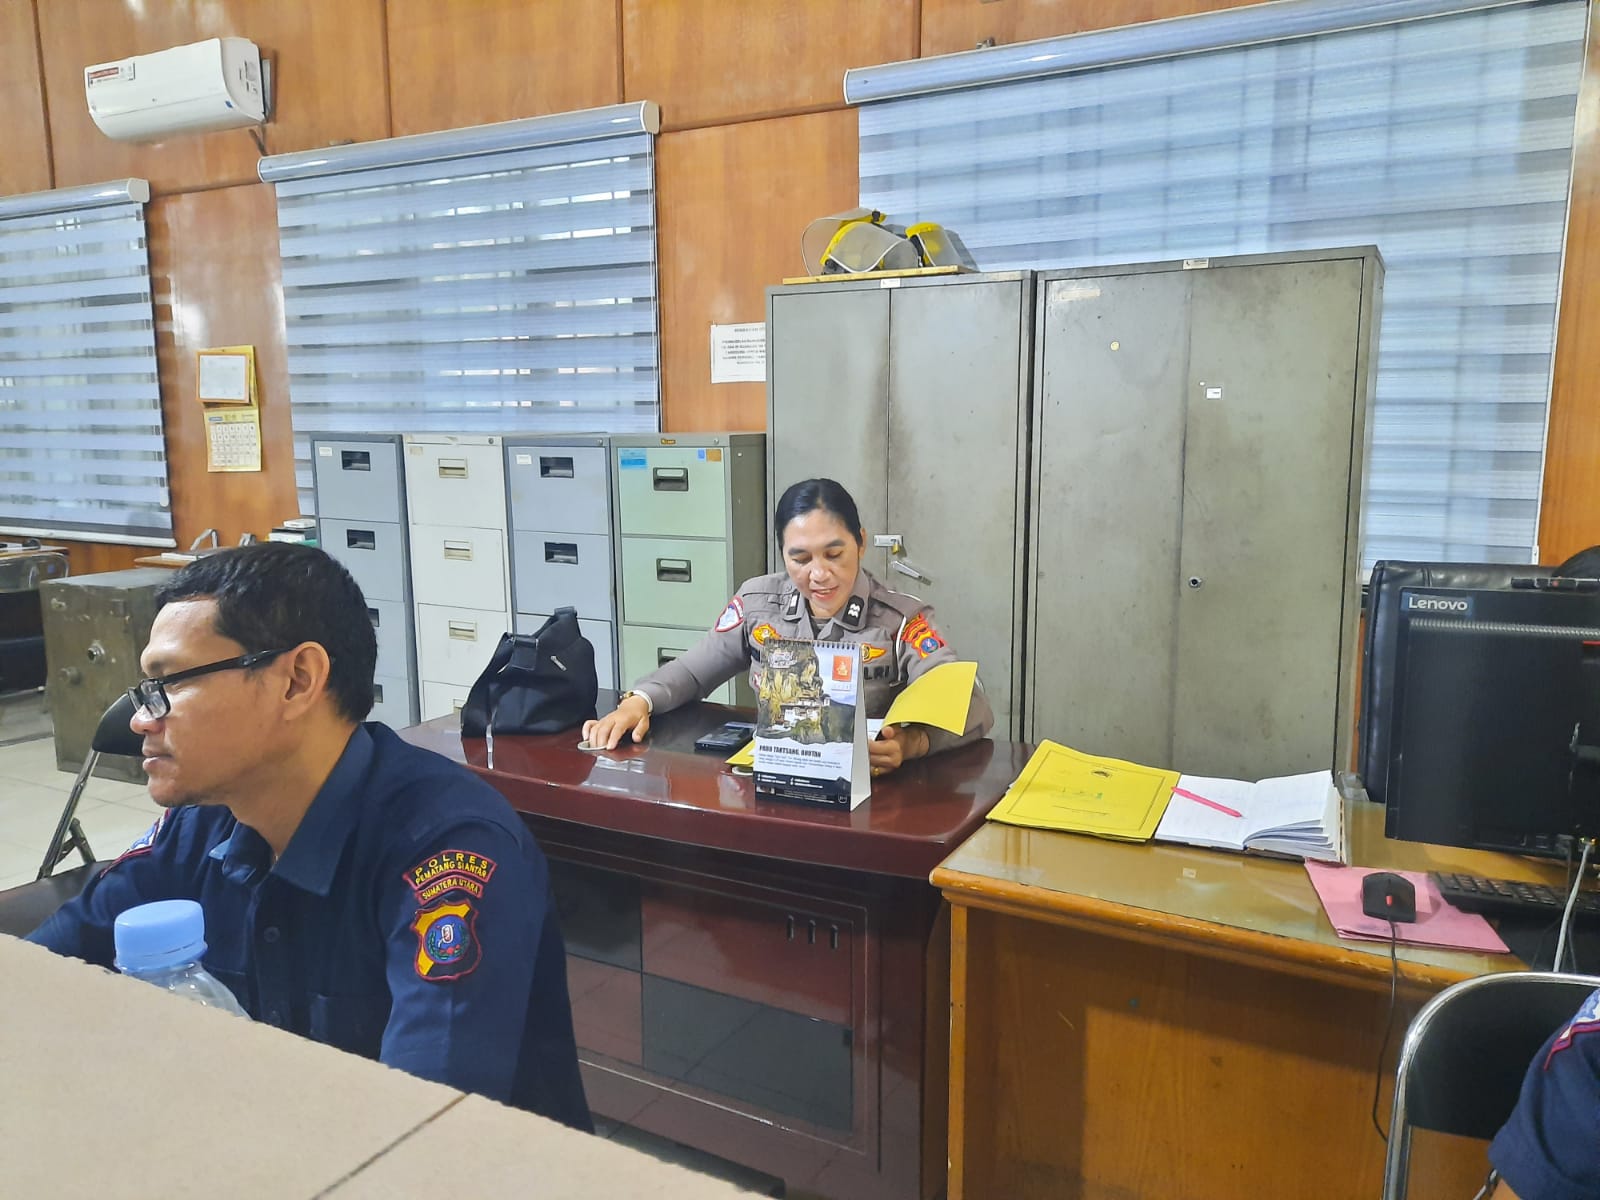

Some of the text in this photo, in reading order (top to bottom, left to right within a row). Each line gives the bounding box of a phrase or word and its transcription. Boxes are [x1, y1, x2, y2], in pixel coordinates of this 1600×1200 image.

[1408, 596, 1468, 611] Lenovo
[415, 853, 488, 877] POLRES
[415, 861, 487, 885] PEMATANG SIANTAR
[422, 878, 478, 899] SUMATERA UTARA
